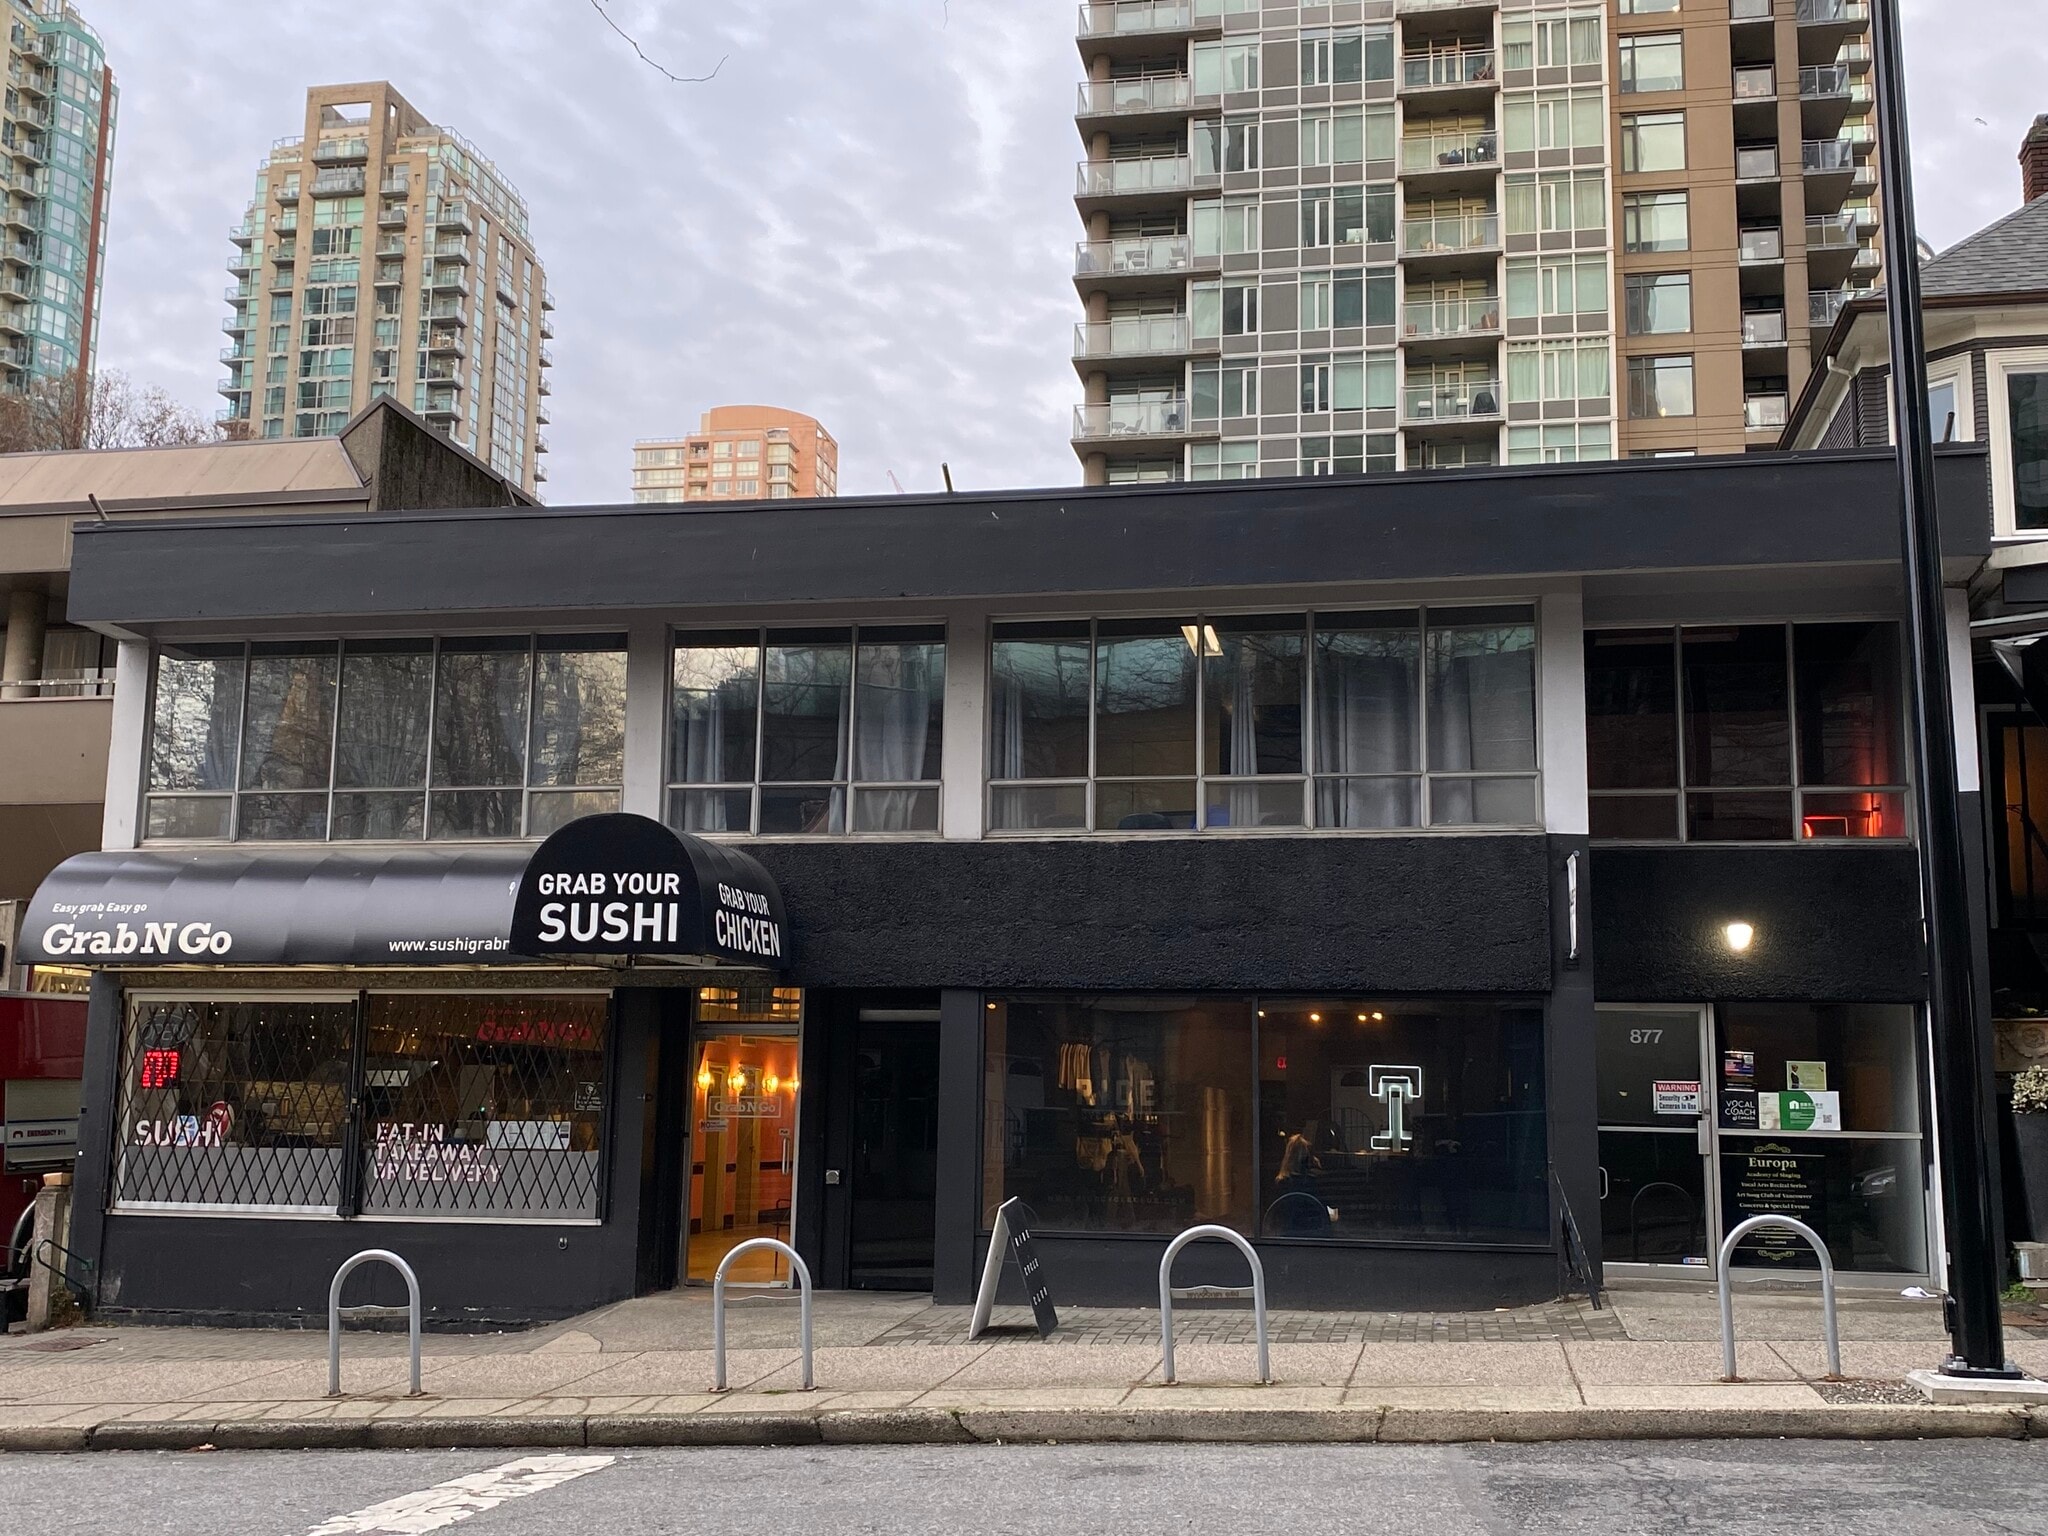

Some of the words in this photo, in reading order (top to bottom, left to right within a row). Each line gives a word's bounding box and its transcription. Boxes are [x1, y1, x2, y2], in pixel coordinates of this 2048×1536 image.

[538, 873, 605, 895] GRAB
[612, 873, 680, 895] YOUR
[718, 882, 745, 910] GRAB
[743, 890, 770, 916] YOUR
[52, 903, 78, 915] Easy
[79, 902, 104, 914] grab
[106, 902, 132, 914] Easy
[134, 904, 148, 914] go
[537, 902, 678, 942] SUSHI
[715, 909, 781, 957] CHICKEN
[1629, 1029, 1663, 1044] 877
[1657, 1084, 1697, 1092] WARNING
[1658, 1094, 1680, 1102] Security
[1725, 1100, 1755, 1108] VOCAL
[1724, 1108, 1756, 1116] COACH
[376, 1143, 485, 1162] TAKEAWAY
[1748, 1157, 1797, 1171] Europa
[405, 1163, 502, 1183] DELIVERY
